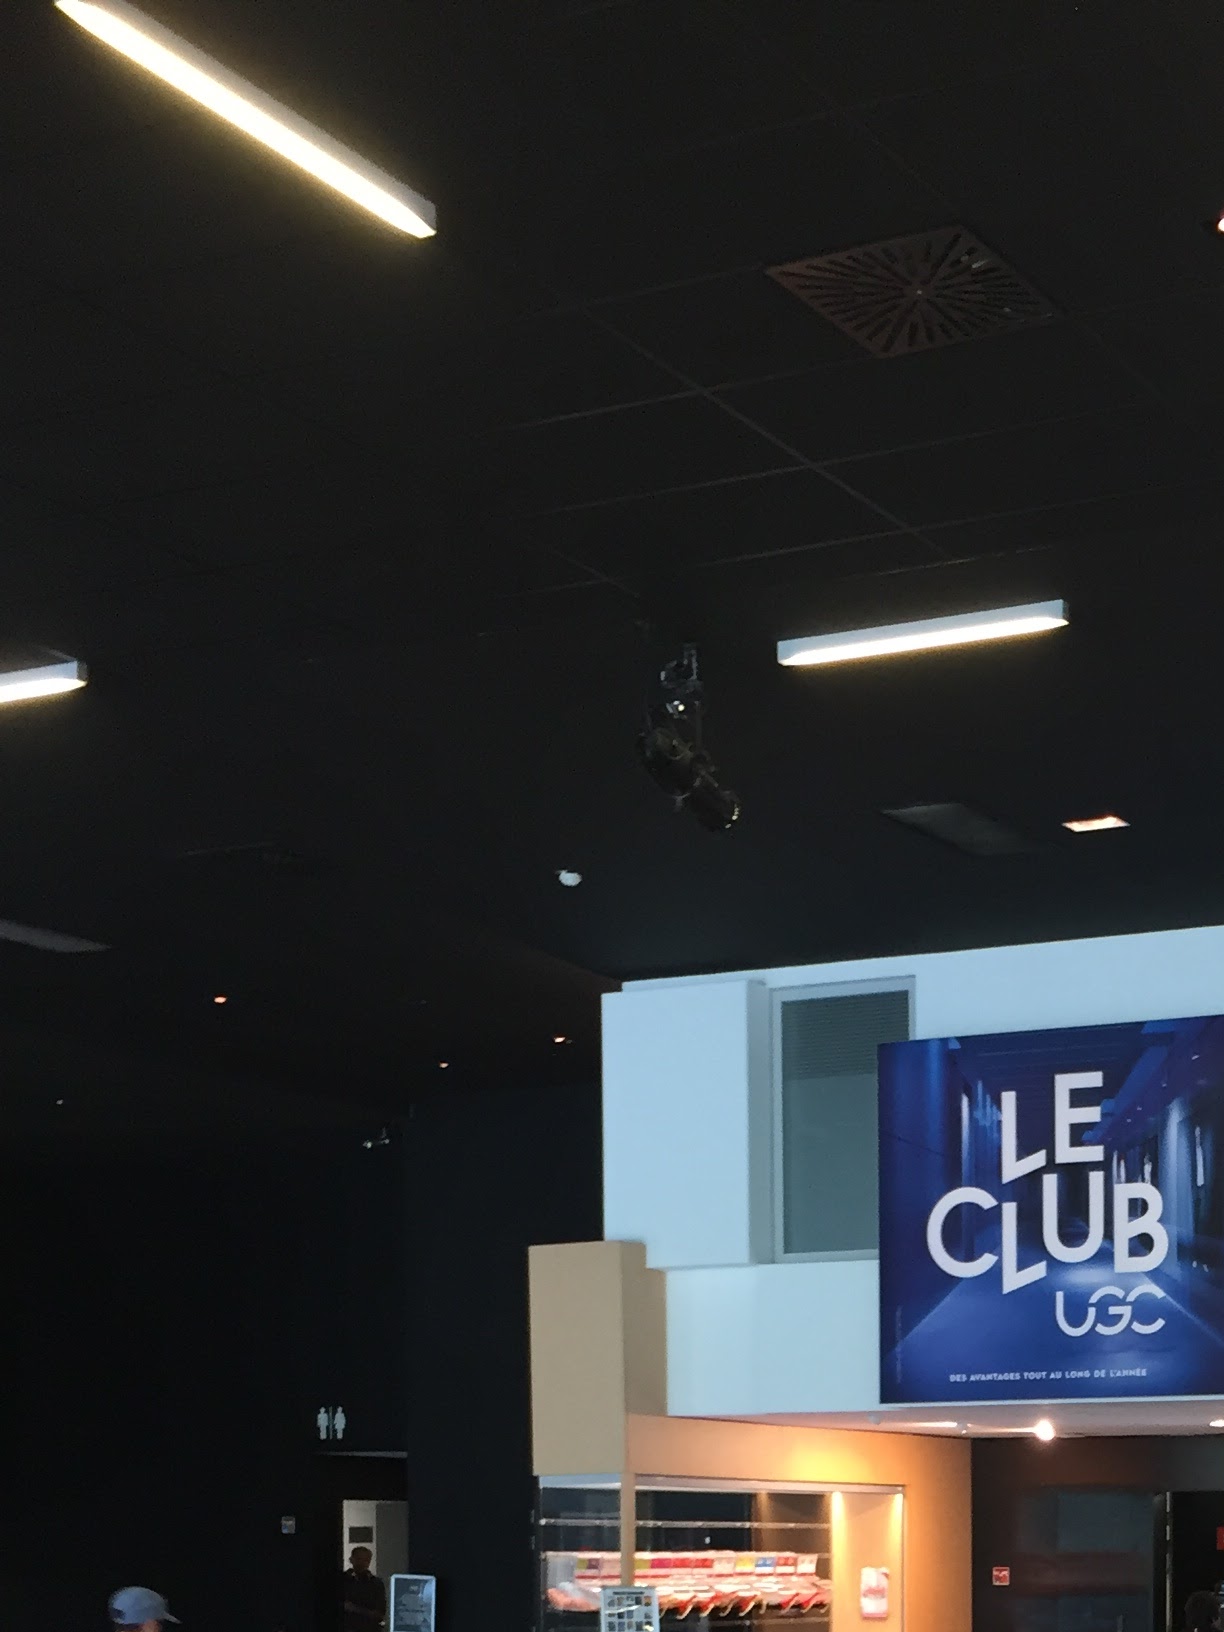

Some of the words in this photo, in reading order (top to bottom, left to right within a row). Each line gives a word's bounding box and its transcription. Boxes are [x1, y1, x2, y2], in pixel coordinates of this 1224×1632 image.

[1001, 1071, 1104, 1185] LE
[927, 1171, 1169, 1294] CLUB
[1055, 1285, 1166, 1337] UGC
[950, 1374, 967, 1382] DES
[969, 1372, 1021, 1381] AVANTAGES
[1023, 1371, 1047, 1380] TOUT
[1049, 1371, 1062, 1379] AU
[1064, 1370, 1090, 1379] LONG
[1094, 1369, 1106, 1378] DE
[1109, 1368, 1147, 1377] L'ANNÉE
